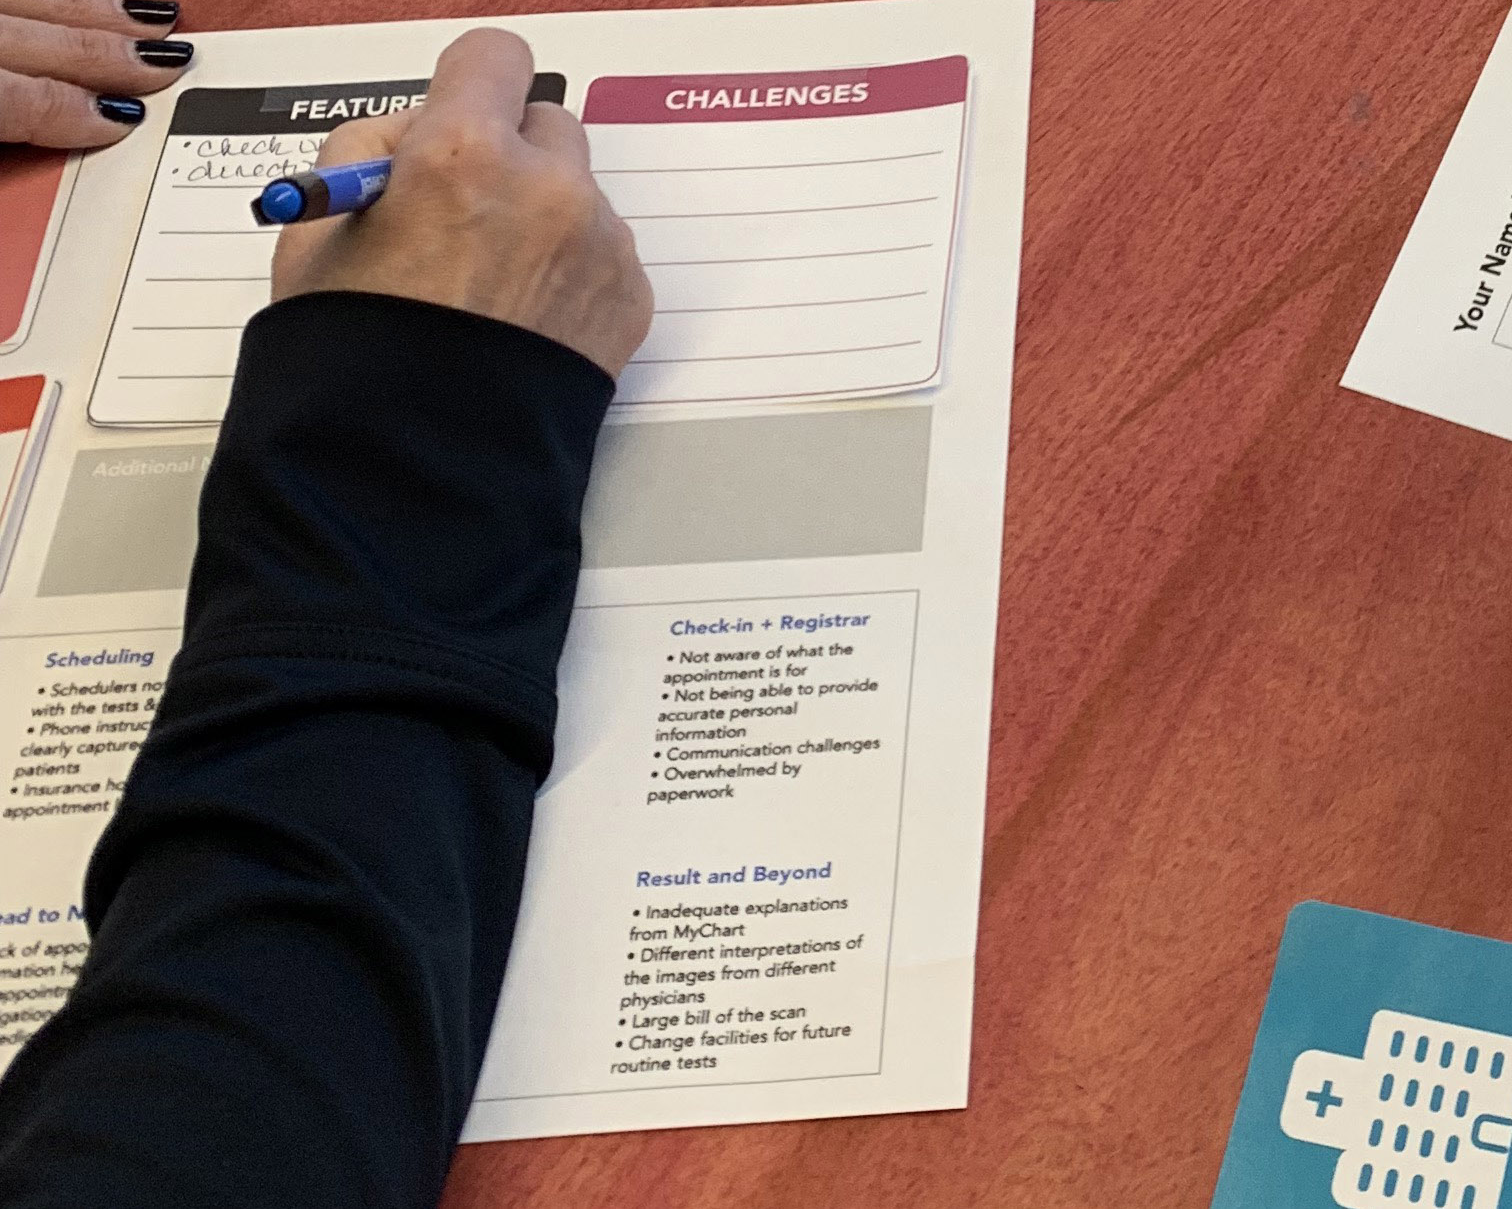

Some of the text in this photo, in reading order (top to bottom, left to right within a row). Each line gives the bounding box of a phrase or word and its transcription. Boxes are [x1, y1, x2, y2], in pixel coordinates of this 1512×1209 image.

[665, 80, 870, 110] CHALLENGES
[289, 94, 428, 122] FEATURE
[1453, 282, 1493, 332] Your
[92, 457, 196, 477] Additional
[670, 613, 871, 636] Check-in + Registrar
[44, 648, 155, 668] Scheduling
[679, 643, 854, 664] Not aware of what the
[663, 663, 808, 687] appointment is for
[666, 738, 881, 761] Communication challenges
[637, 861, 832, 887] Result and Beyond
[646, 897, 848, 920] Inadequate explanations
[629, 923, 745, 942] from MyChart
